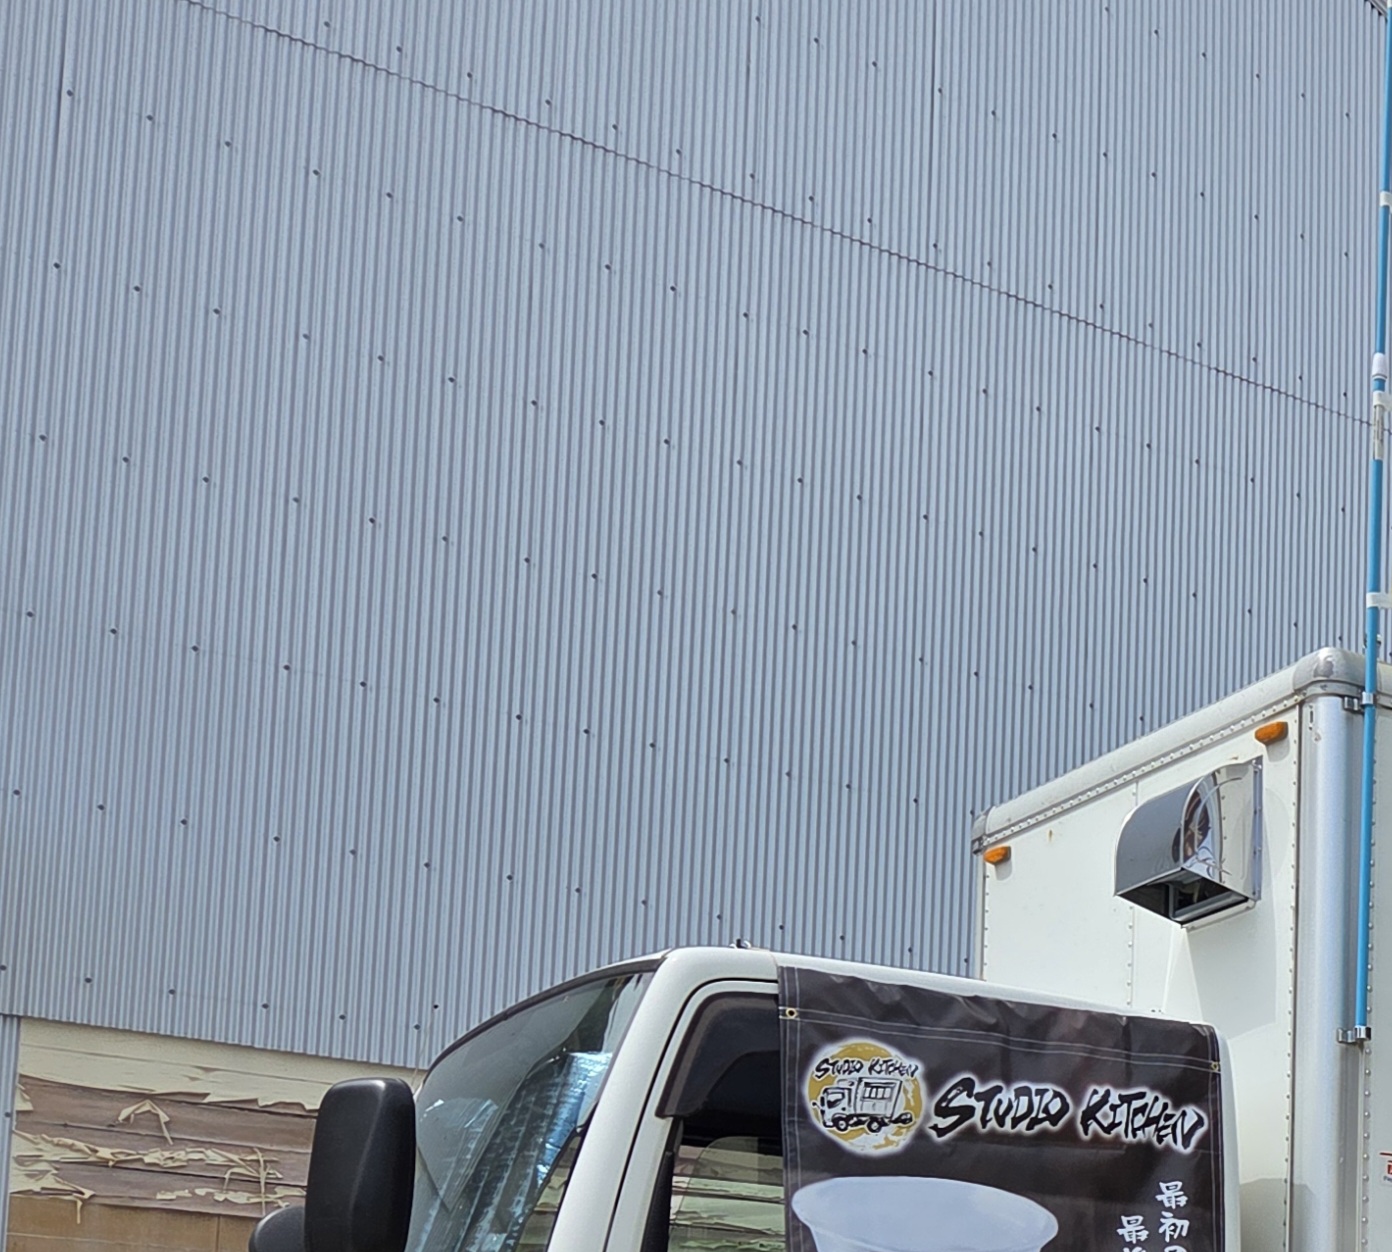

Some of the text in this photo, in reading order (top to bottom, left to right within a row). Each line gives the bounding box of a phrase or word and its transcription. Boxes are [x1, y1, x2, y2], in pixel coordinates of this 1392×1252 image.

[815, 1058, 919, 1079] STUDIO KITCHEN
[927, 1077, 1205, 1150] STUDIO KITCHEN
